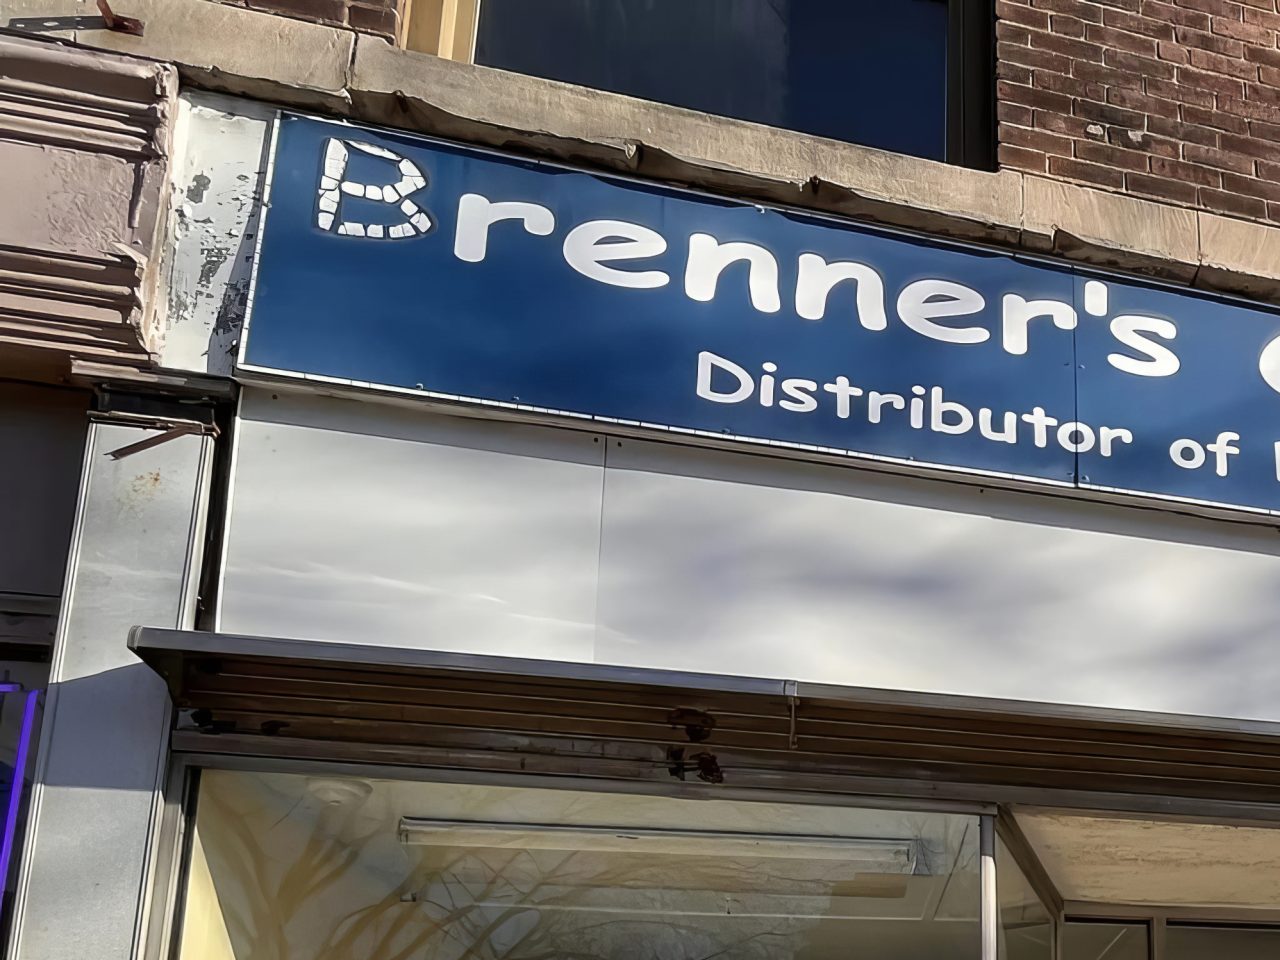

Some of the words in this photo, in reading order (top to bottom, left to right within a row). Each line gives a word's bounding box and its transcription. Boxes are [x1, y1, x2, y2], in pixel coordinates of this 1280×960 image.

[314, 136, 1182, 379] Brenner's
[695, 350, 1134, 460] Distributor
[1168, 430, 1240, 480] of
